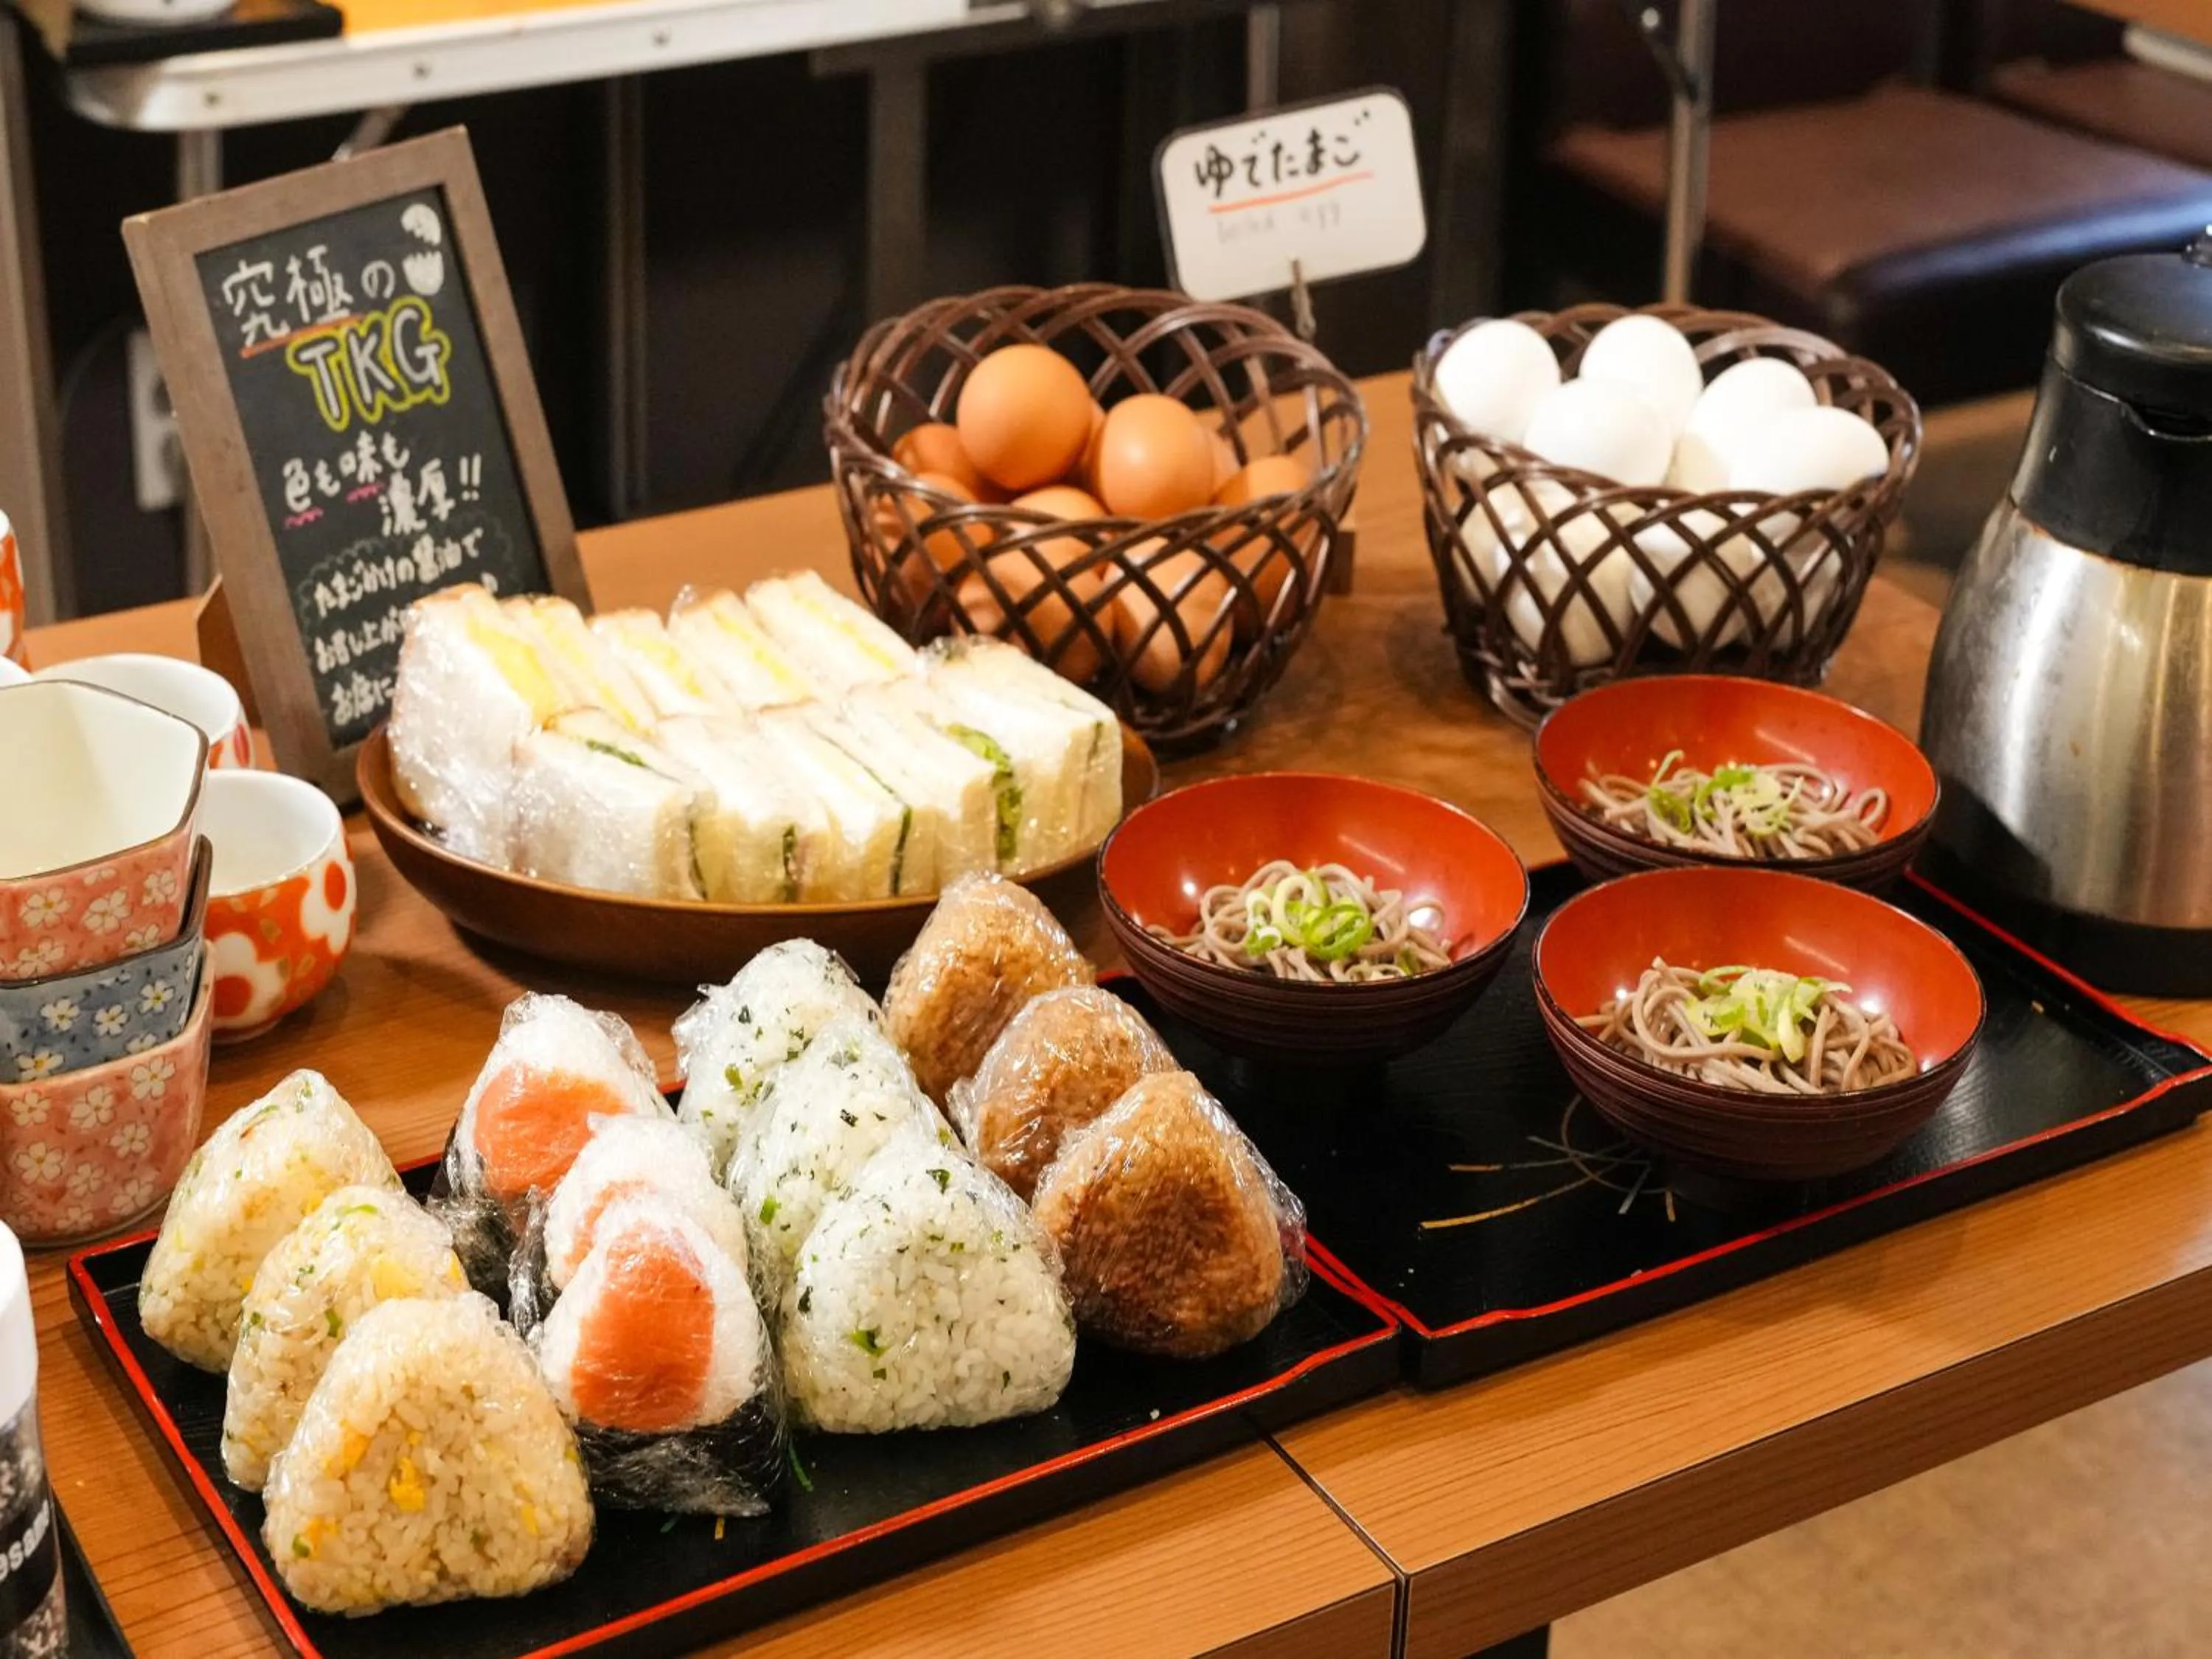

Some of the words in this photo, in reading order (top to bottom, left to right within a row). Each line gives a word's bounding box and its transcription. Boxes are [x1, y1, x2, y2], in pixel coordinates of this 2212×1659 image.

[1194, 108, 1371, 198] ゆでたまご
[223, 245, 395, 347] 究極の
[288, 297, 451, 429] TKG
[283, 430, 410, 512] 色も味も
